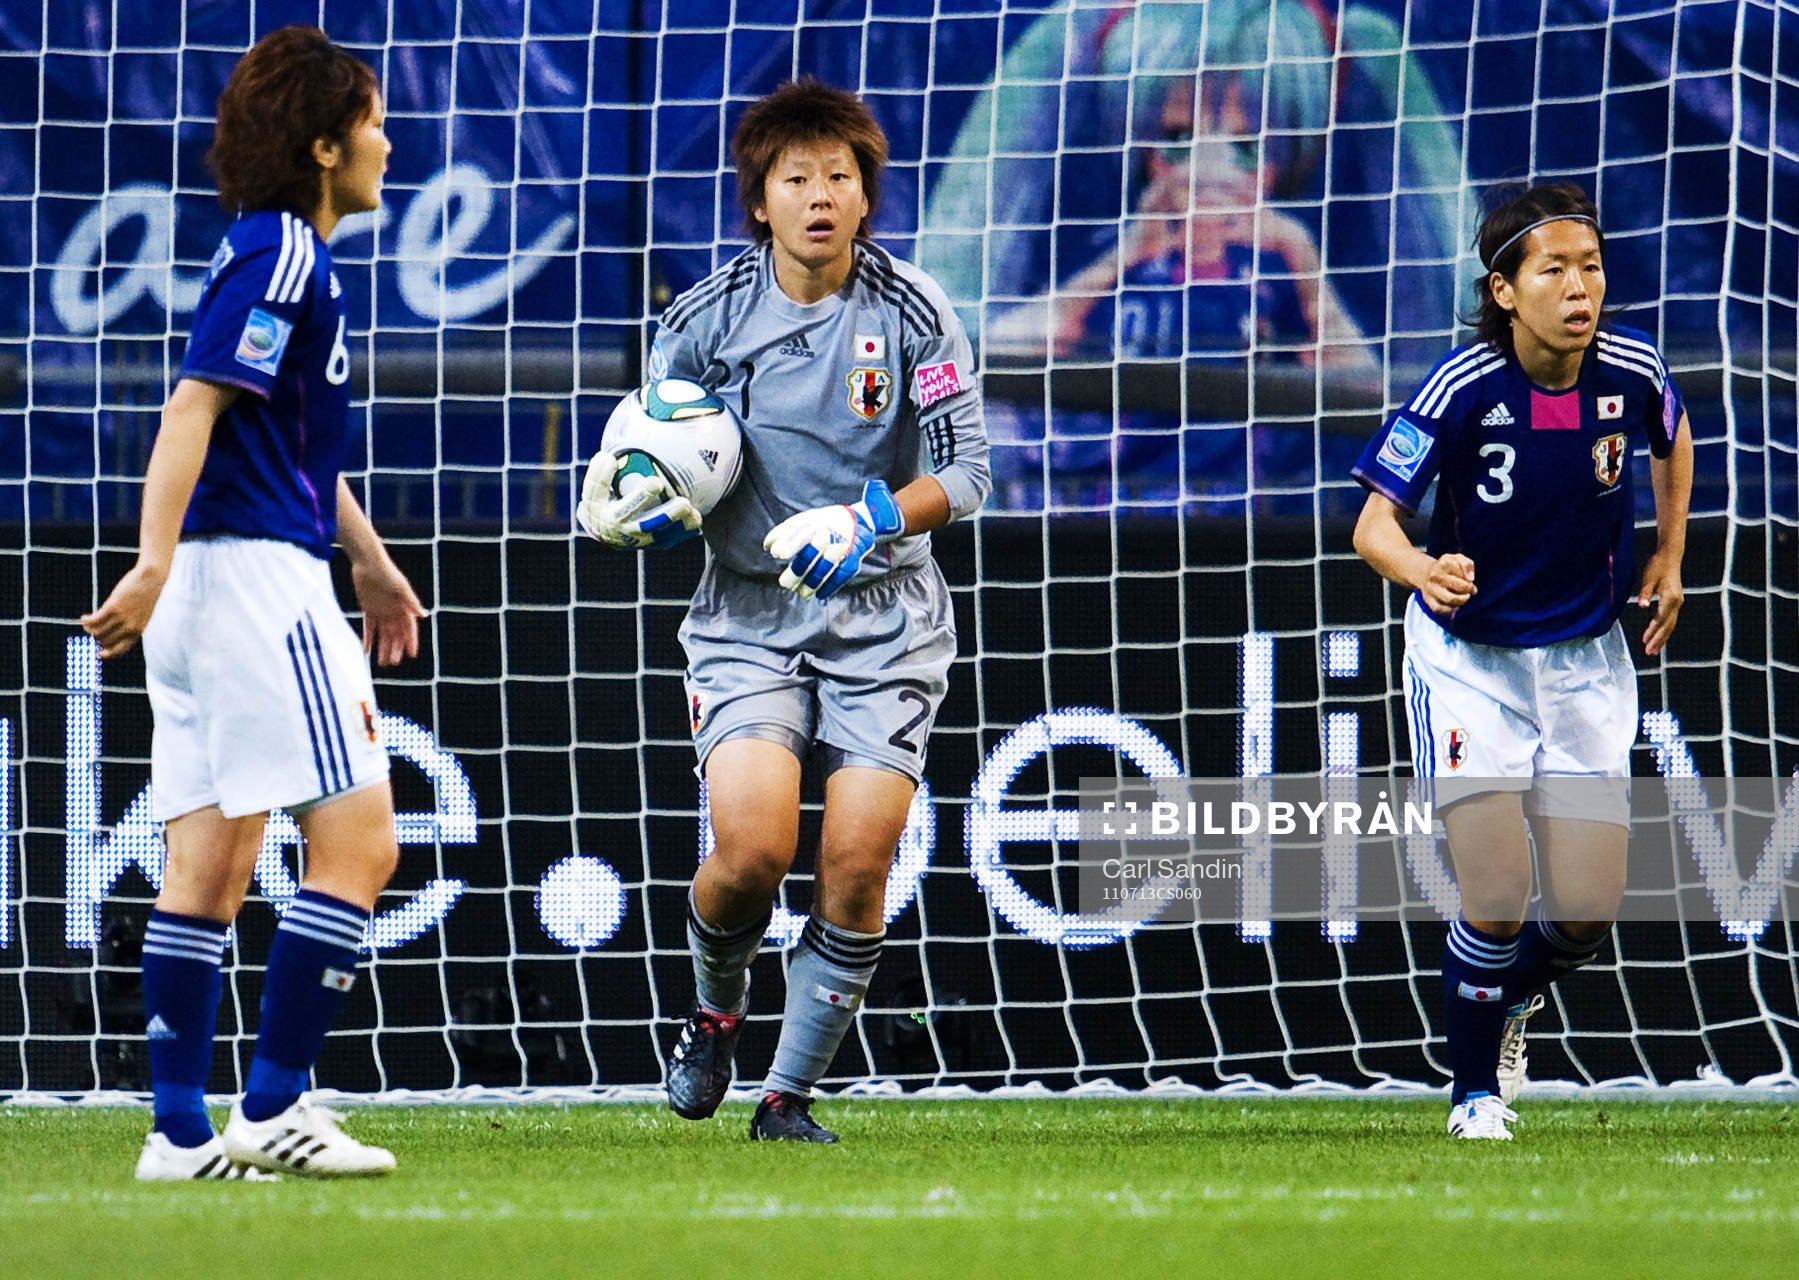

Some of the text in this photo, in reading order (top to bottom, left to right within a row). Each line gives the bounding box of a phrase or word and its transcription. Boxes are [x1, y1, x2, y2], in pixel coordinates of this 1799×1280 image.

[325, 315, 350, 385] 6
[779, 347, 815, 358] adidas
[920, 365, 945, 386] LIVE
[921, 375, 956, 401] YOUR
[1481, 416, 1515, 427] adidas
[1477, 443, 1515, 504] 3
